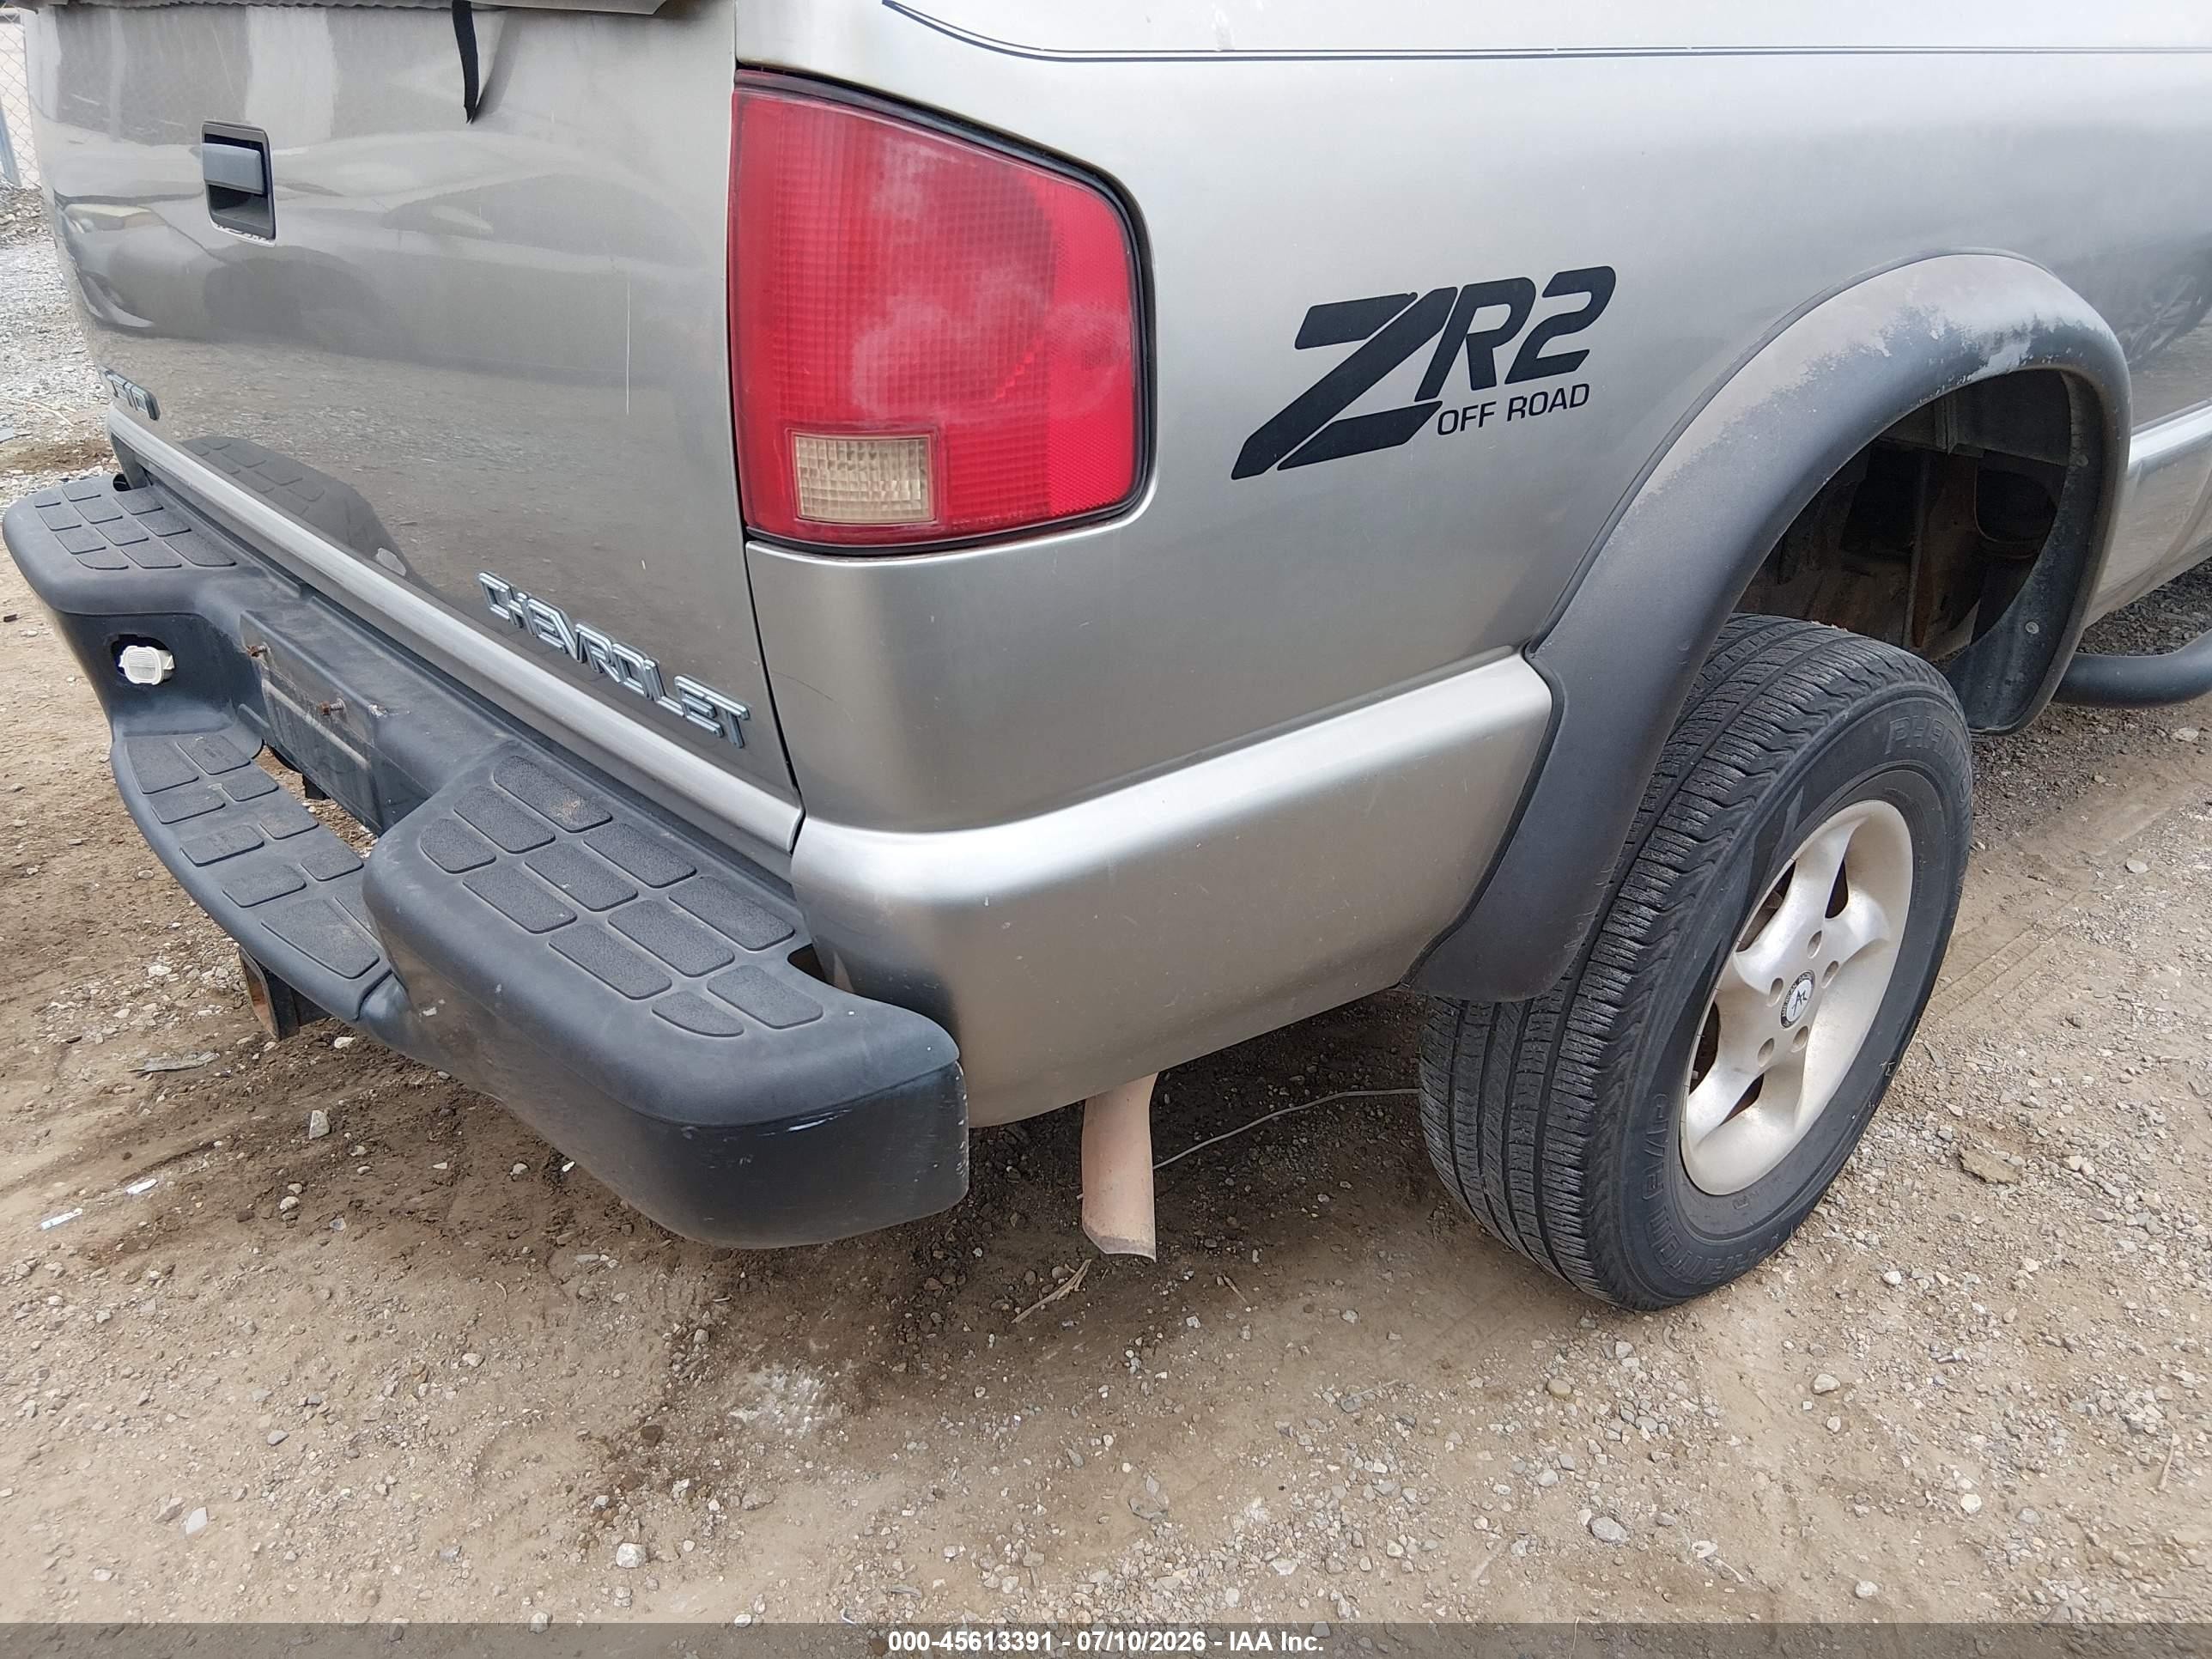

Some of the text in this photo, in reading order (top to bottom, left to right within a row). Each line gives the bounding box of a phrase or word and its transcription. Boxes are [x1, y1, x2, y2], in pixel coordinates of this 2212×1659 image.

[1231, 265, 1617, 481] ZR2
[1437, 382, 1590, 436] OFF ROAD
[478, 571, 750, 749] CHEVROLET
